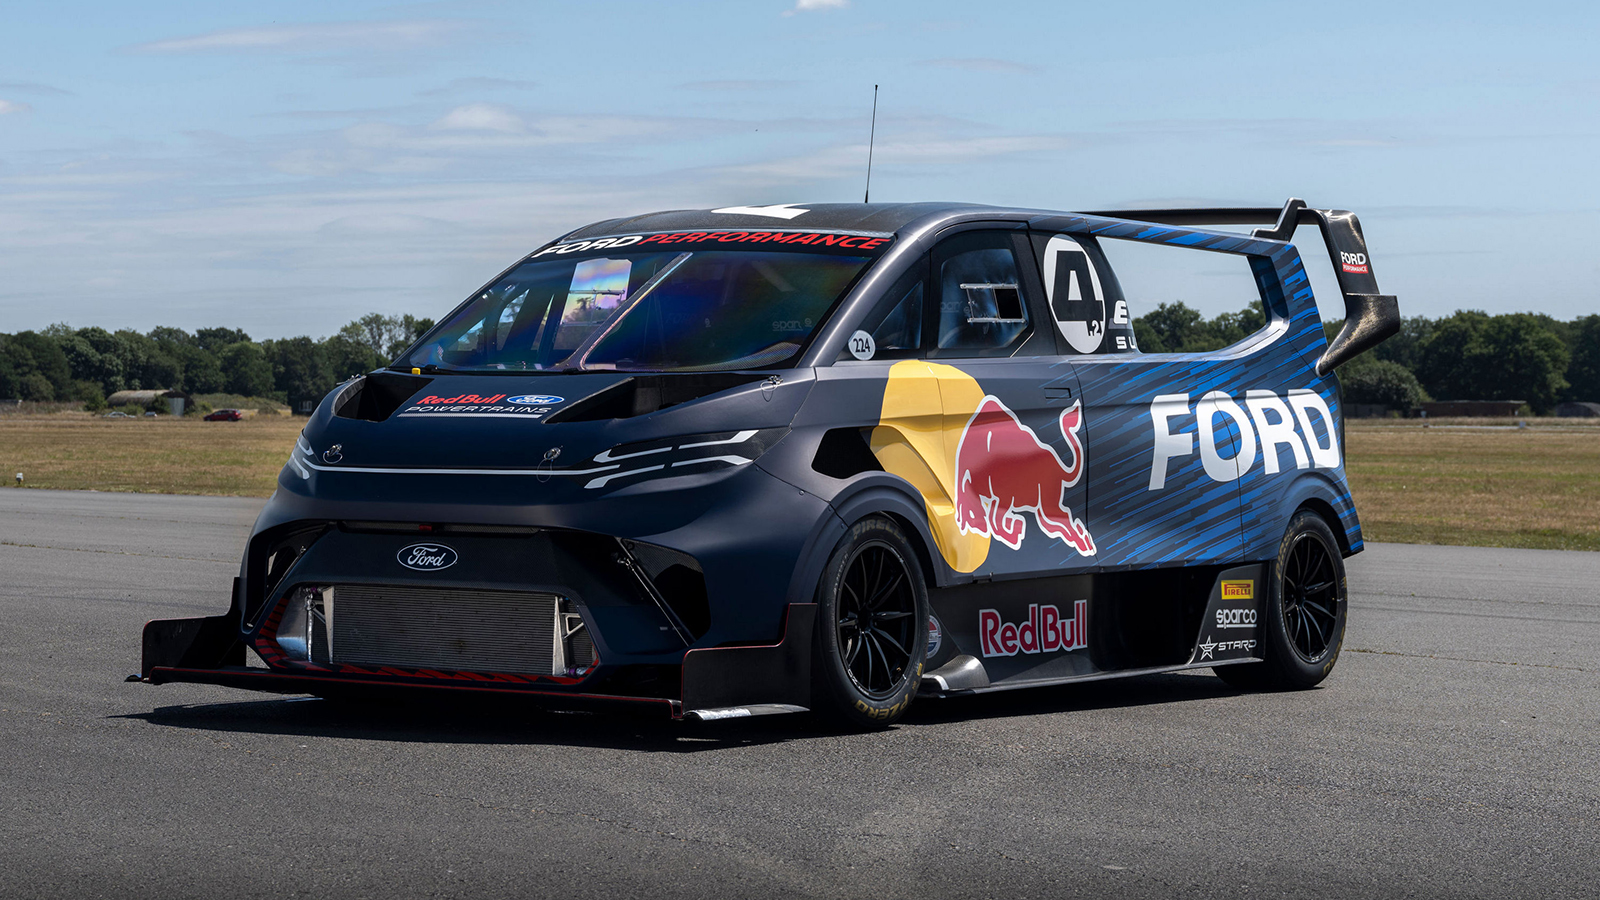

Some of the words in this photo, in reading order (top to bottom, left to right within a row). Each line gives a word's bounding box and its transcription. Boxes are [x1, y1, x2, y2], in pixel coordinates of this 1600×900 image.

[531, 235, 644, 259] FORD
[637, 231, 893, 250] PERFORMANCE
[1340, 251, 1367, 265] FORD
[852, 338, 871, 353] 224
[404, 405, 552, 414] POWERTRAINS
[1148, 388, 1341, 491] FORD
[407, 546, 447, 567] Ford
[1223, 583, 1251, 596] PIRELLI
[1216, 608, 1258, 630] sparco
[1218, 639, 1258, 652] STARD
